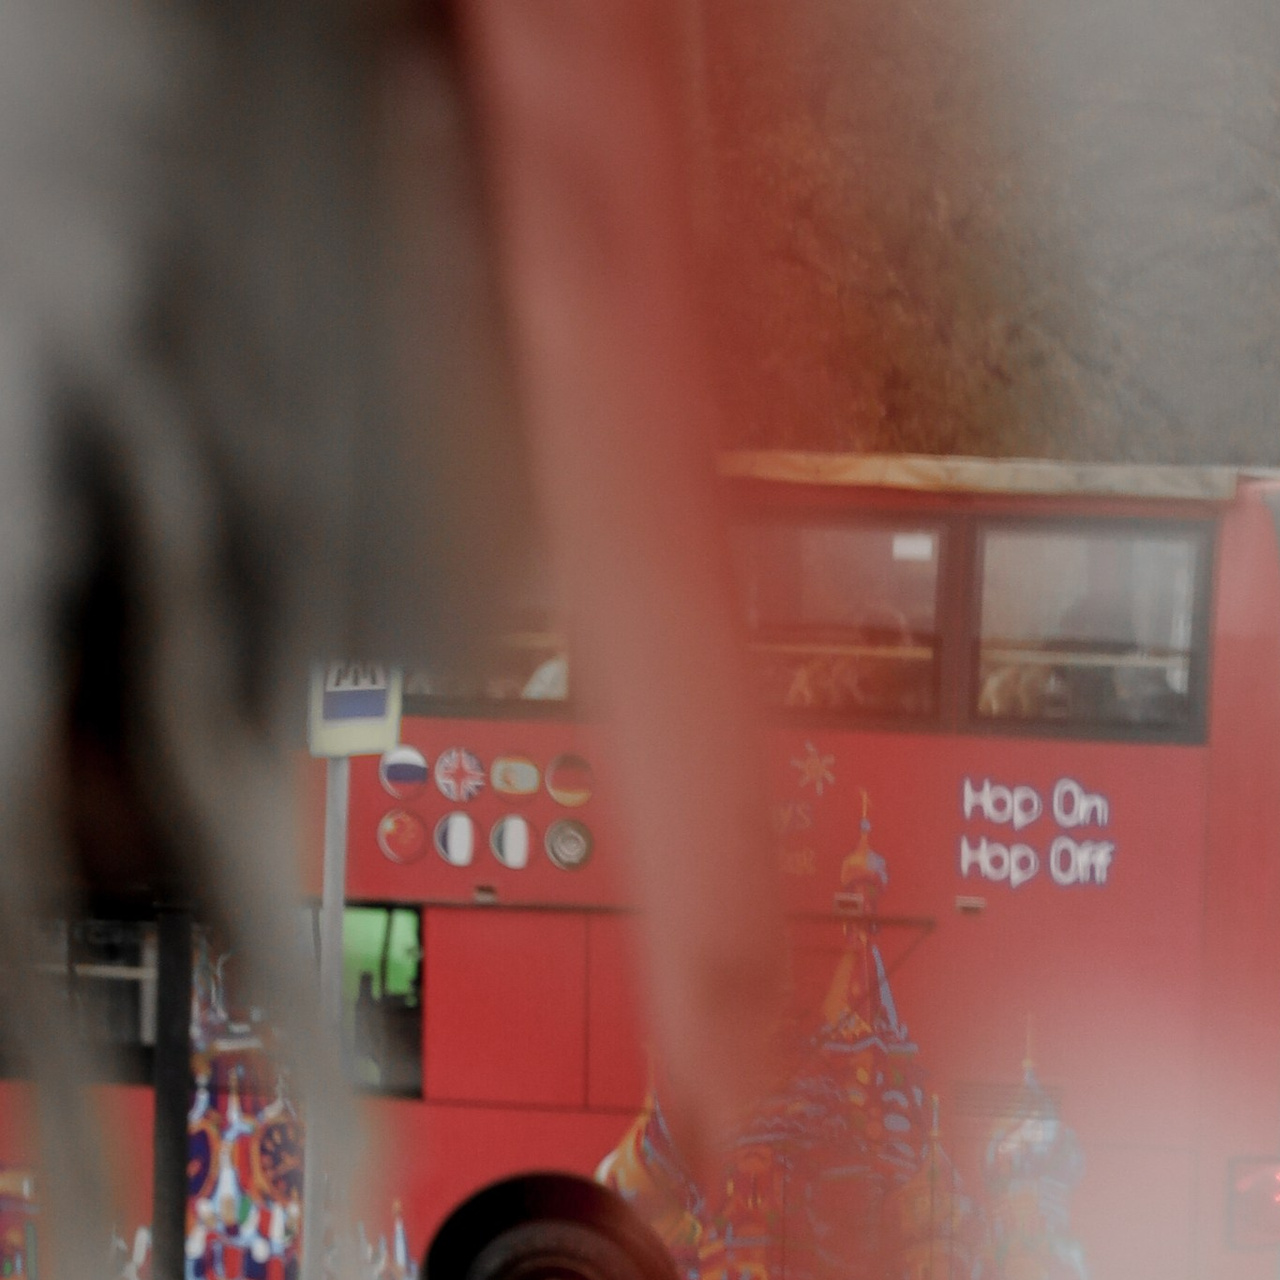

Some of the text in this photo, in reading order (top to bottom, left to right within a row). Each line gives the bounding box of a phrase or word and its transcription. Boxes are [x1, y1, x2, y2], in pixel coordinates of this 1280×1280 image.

[963, 776, 1109, 831] Hop On
[960, 834, 1115, 888] Hop Off
